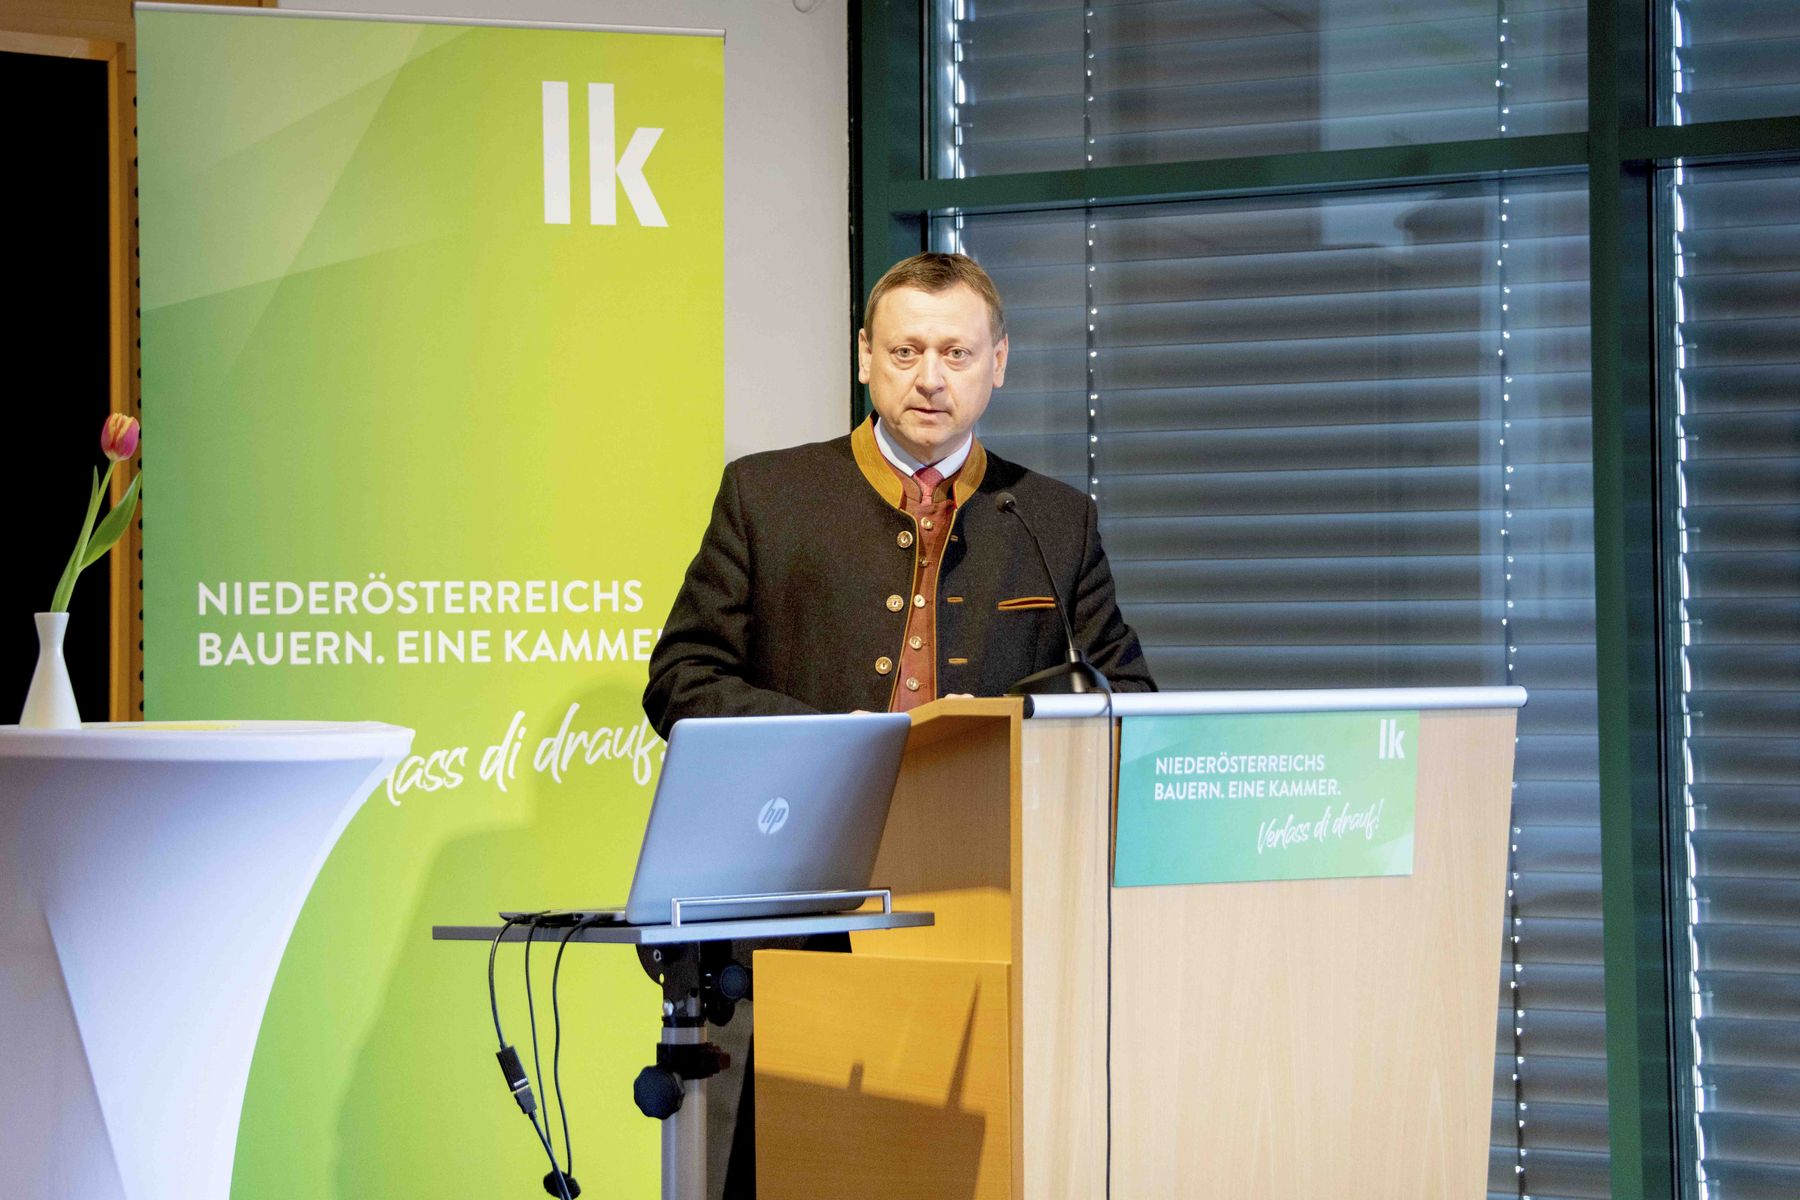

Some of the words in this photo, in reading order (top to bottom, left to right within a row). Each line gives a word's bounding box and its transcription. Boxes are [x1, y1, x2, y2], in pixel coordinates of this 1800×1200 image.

[198, 572, 643, 616] NIEDERÖSTERREICHS
[198, 632, 384, 666] BAUERN.
[398, 630, 491, 663] EINE
[504, 628, 663, 662] KAMME
[479, 710, 526, 793] di
[533, 702, 666, 786] drauf
[1155, 752, 1325, 774] NIEDERÖSTERREICHS
[1154, 782, 1224, 800] BAUERN.
[1228, 780, 1264, 798] EINE
[1268, 778, 1341, 797] KAMMER.
[759, 797, 788, 834] hp
[1257, 814, 1310, 854] Verlass
[1314, 805, 1332, 842] di
[1333, 799, 1384, 840] drauf!
